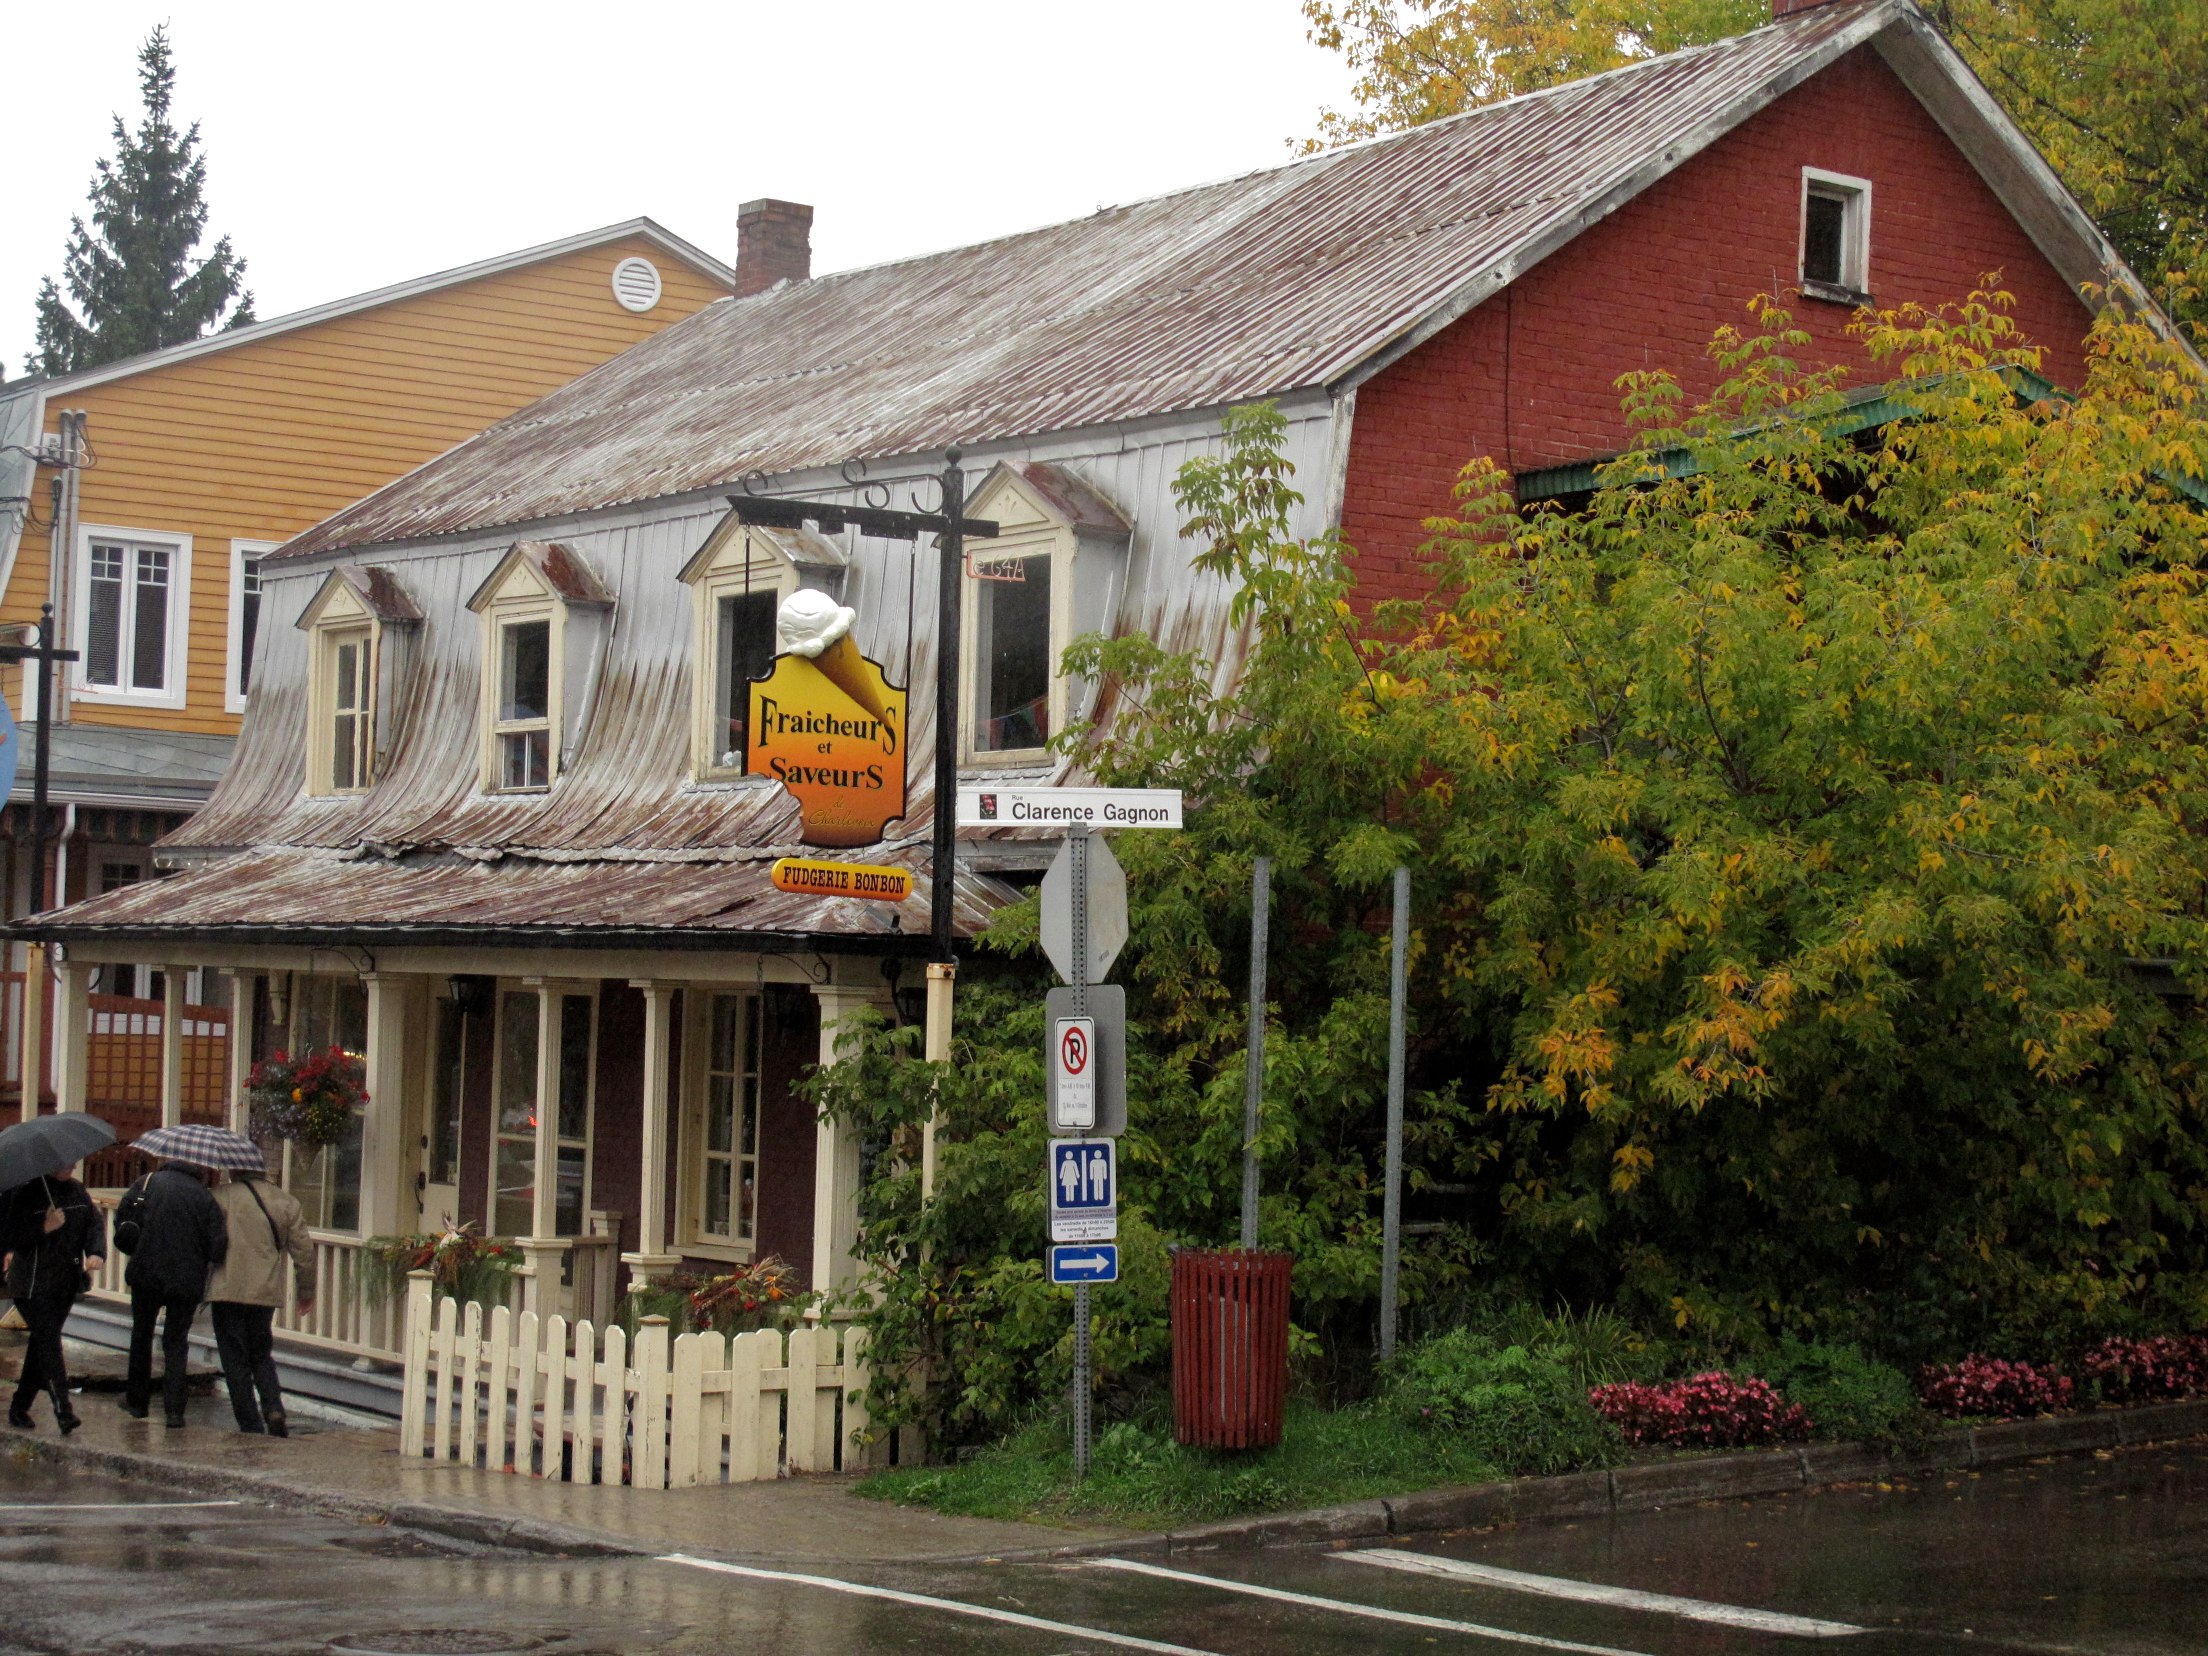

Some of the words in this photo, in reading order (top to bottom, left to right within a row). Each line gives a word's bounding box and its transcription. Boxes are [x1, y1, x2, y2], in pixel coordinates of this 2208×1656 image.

[817, 741, 833, 755] et
[1012, 802, 1094, 820] Clarence
[1103, 803, 1169, 824] Gagnon
[783, 866, 849, 889] FUDGERIE
[854, 872, 906, 894] BONBON
